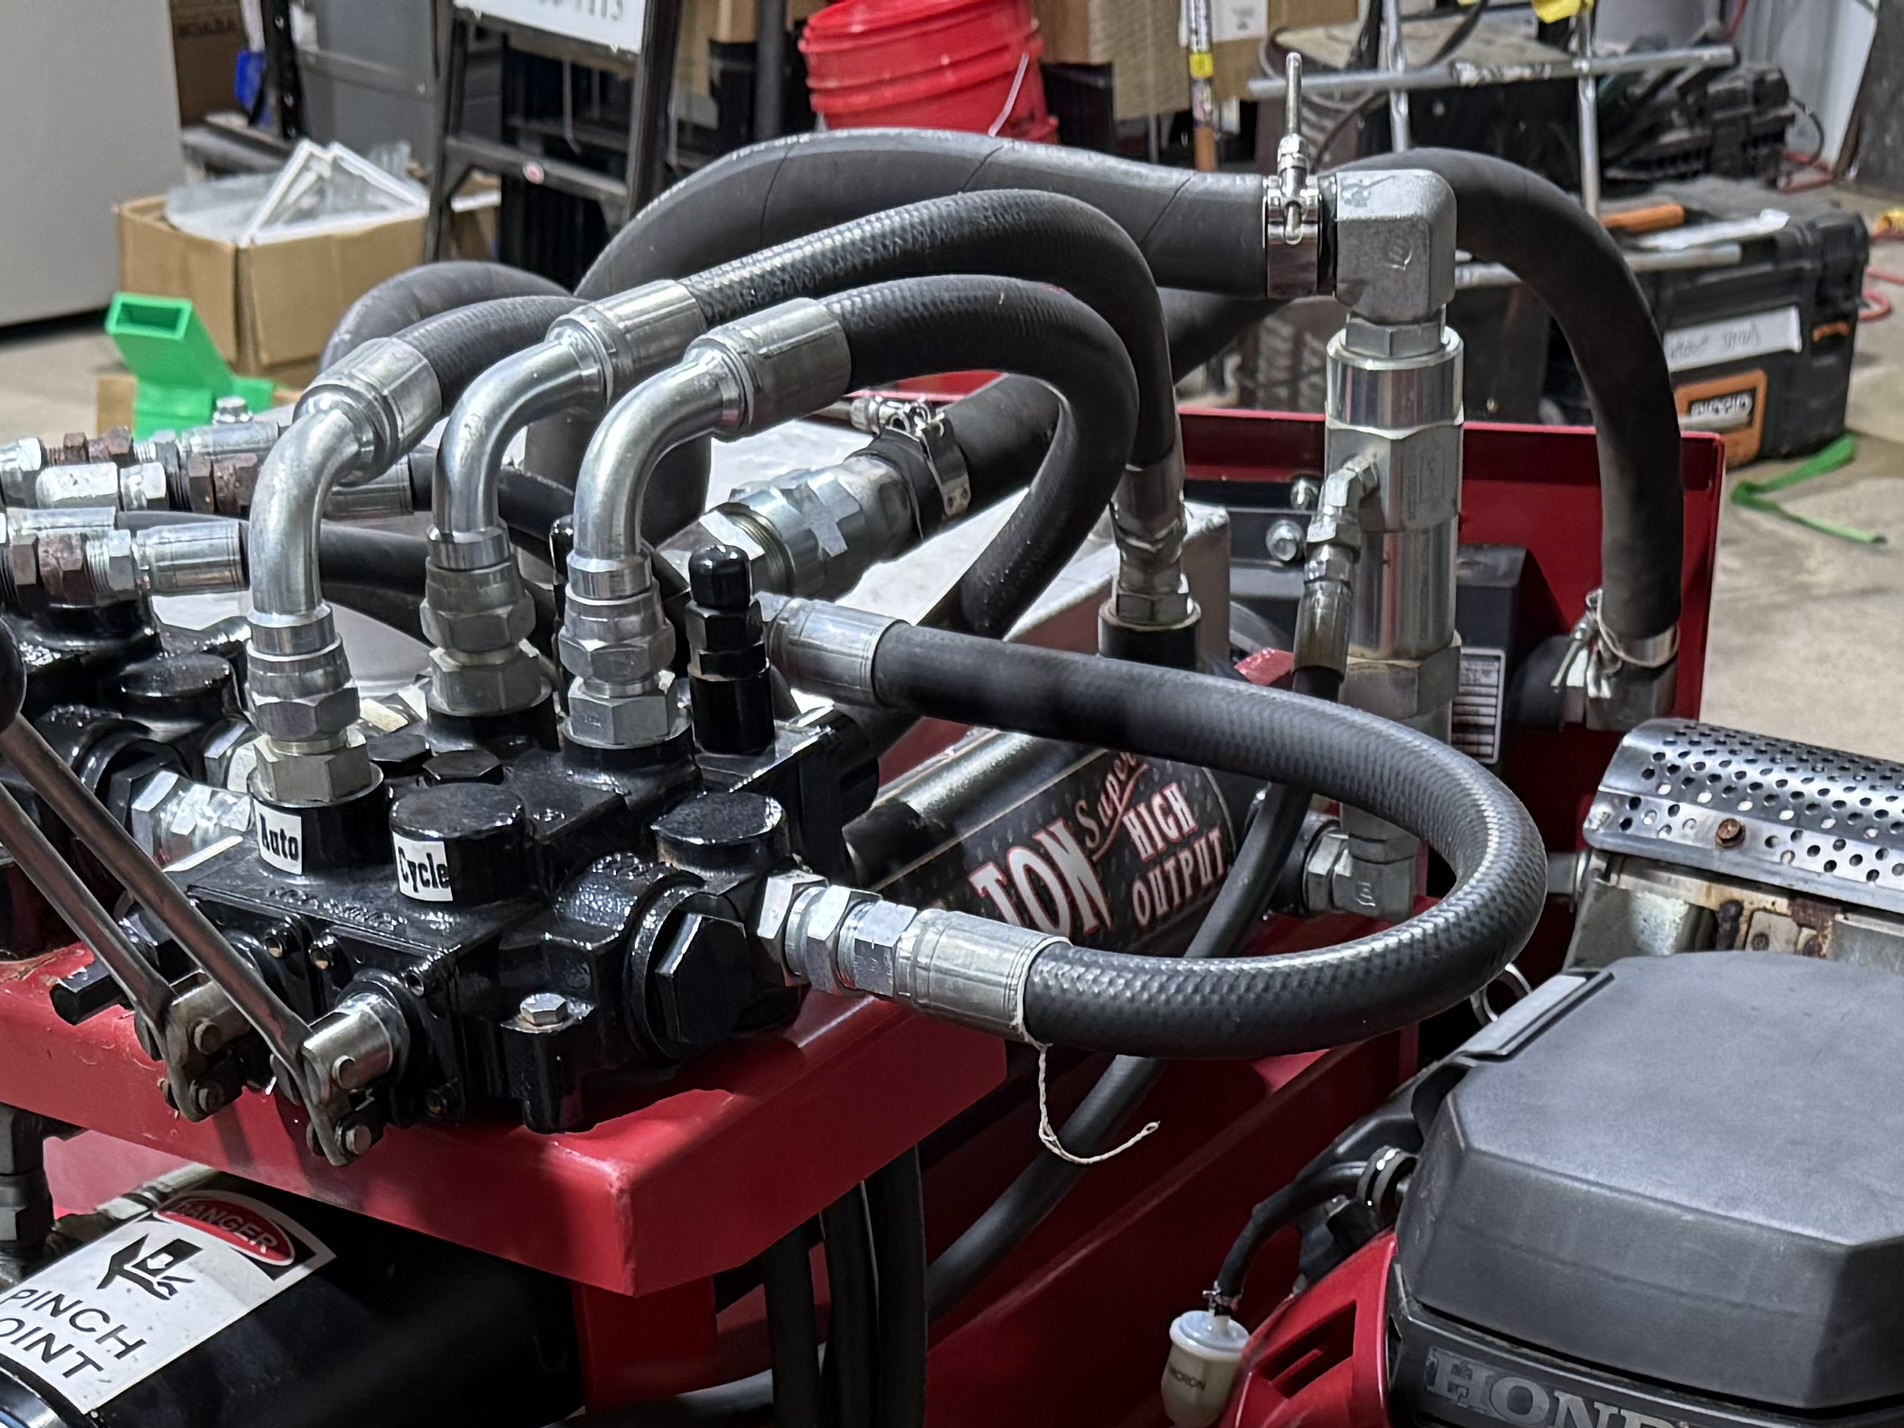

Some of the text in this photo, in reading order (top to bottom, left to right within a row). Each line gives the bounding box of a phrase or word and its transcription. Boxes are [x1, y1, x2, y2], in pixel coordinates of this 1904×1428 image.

[259, 813, 300, 861] Auto
[1122, 782, 1198, 863] HIGH
[398, 847, 450, 893] Cycle
[968, 817, 1114, 938] TON
[1132, 826, 1225, 928] OUTPUT
[176, 1201, 278, 1254] DANGER
